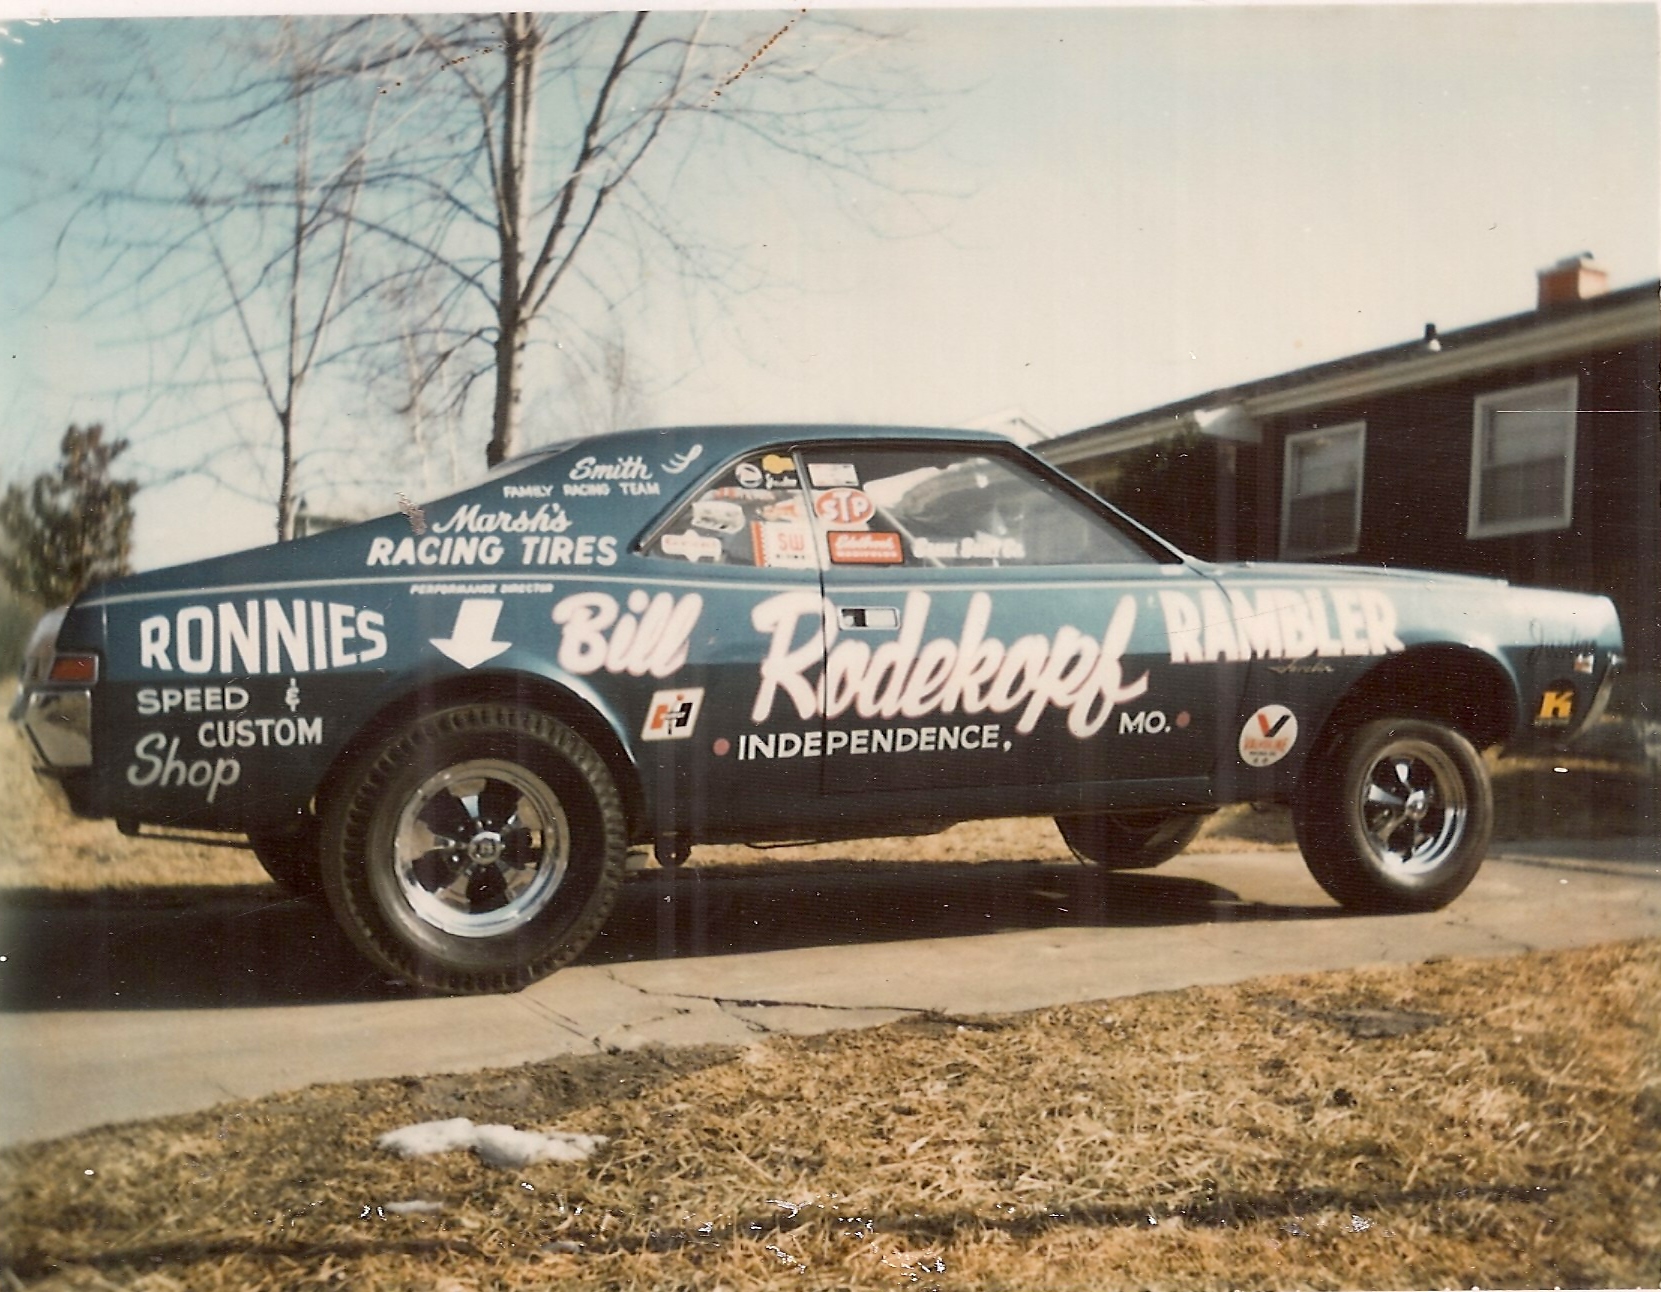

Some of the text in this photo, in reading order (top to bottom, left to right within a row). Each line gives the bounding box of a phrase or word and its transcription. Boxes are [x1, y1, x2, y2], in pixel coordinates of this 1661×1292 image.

[569, 456, 653, 480] Smith
[503, 482, 660, 498] FAMILY RACING TEAM
[432, 503, 572, 534] Marsh's
[821, 492, 870, 522] STP
[366, 536, 618, 566] RACING TIRES
[140, 599, 388, 674] RONNIES
[552, 587, 1406, 738] Bill Rodekopf RAMBLER
[136, 686, 249, 715] SPEED
[199, 717, 323, 748] CUSTOM
[738, 711, 1172, 760] INDEPENDENCE, MO.
[126, 732, 241, 803] Shop
